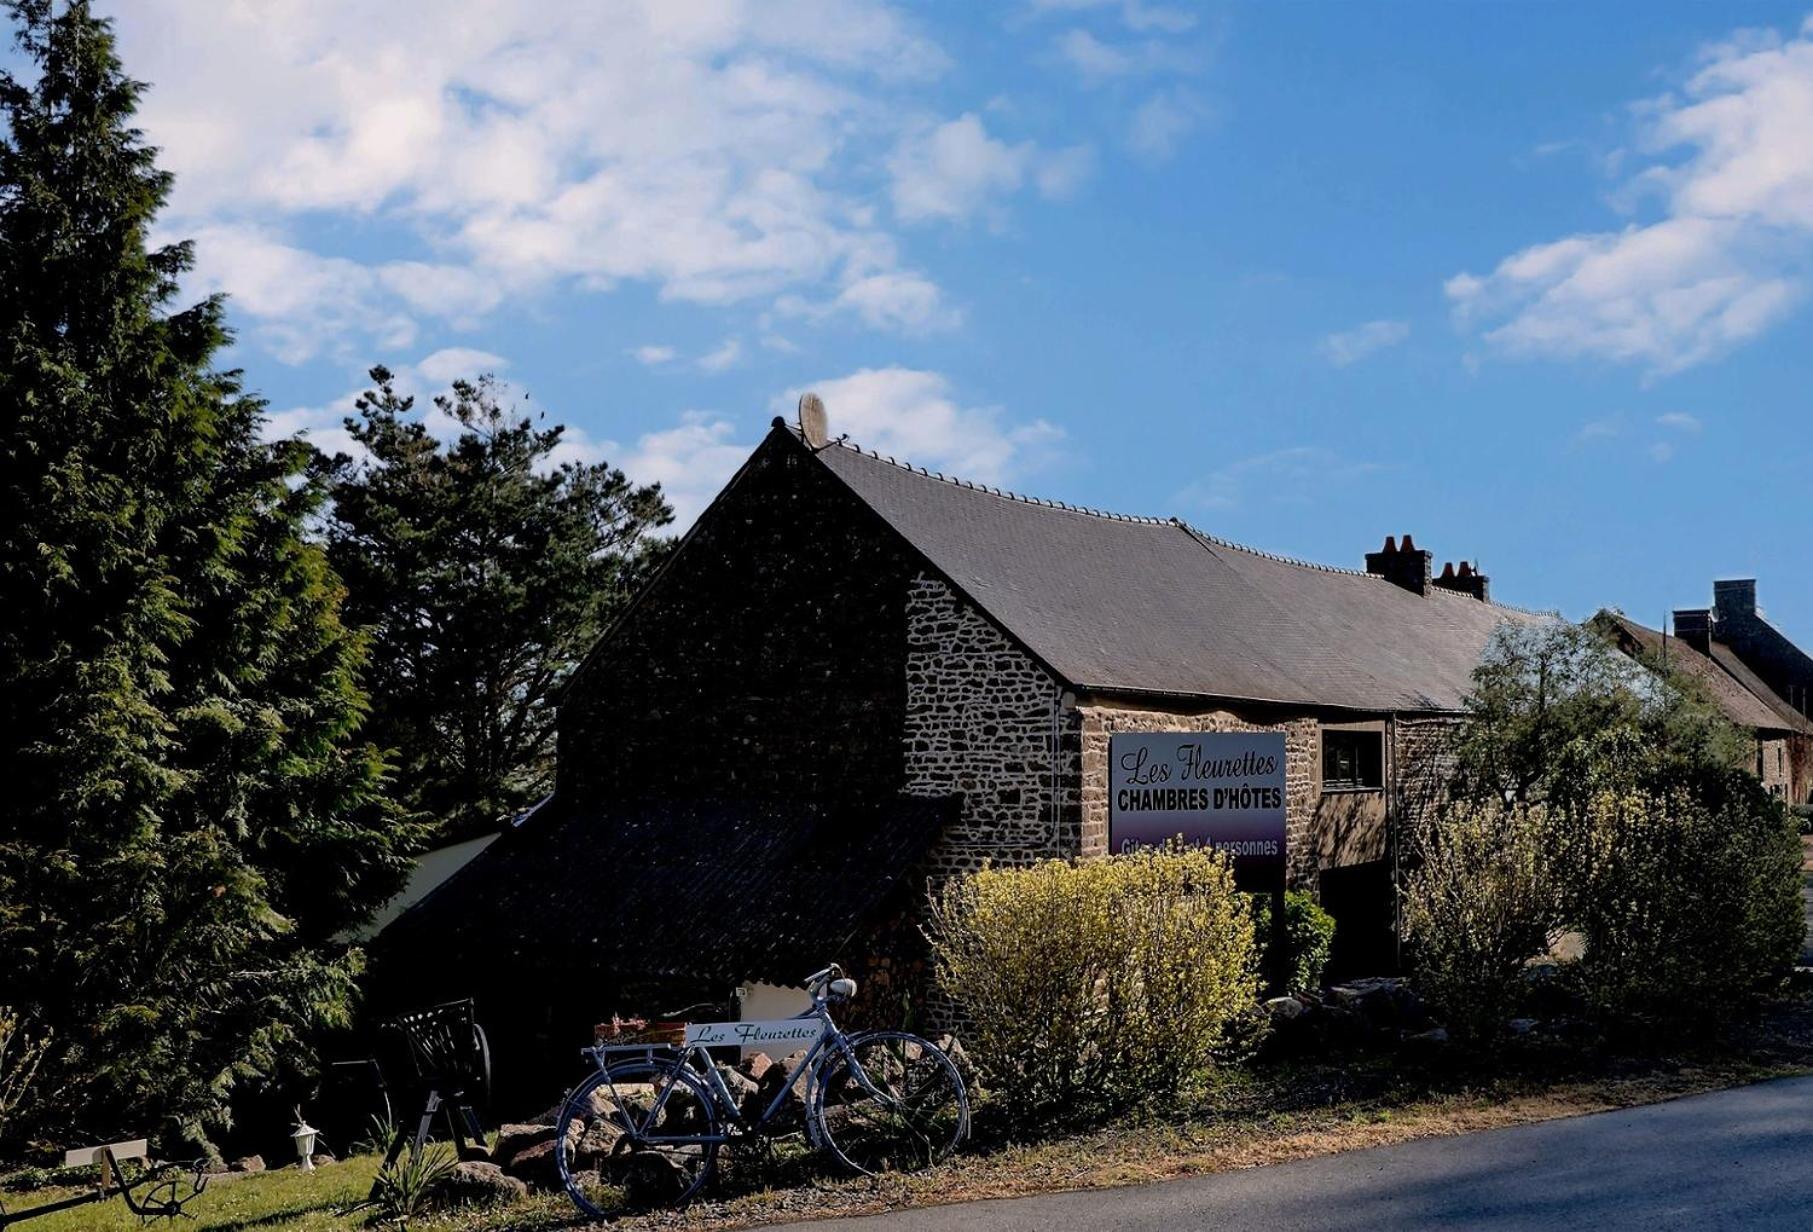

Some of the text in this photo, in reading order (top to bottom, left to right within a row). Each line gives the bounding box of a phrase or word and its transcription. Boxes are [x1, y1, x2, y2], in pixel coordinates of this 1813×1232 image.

[1120, 744, 1278, 785] Les Fleurettes
[1117, 783, 1282, 812] CHAMBRES D'HÔTES
[1215, 839, 1278, 857] personnes
[690, 1023, 817, 1044] Les Fleurettes
